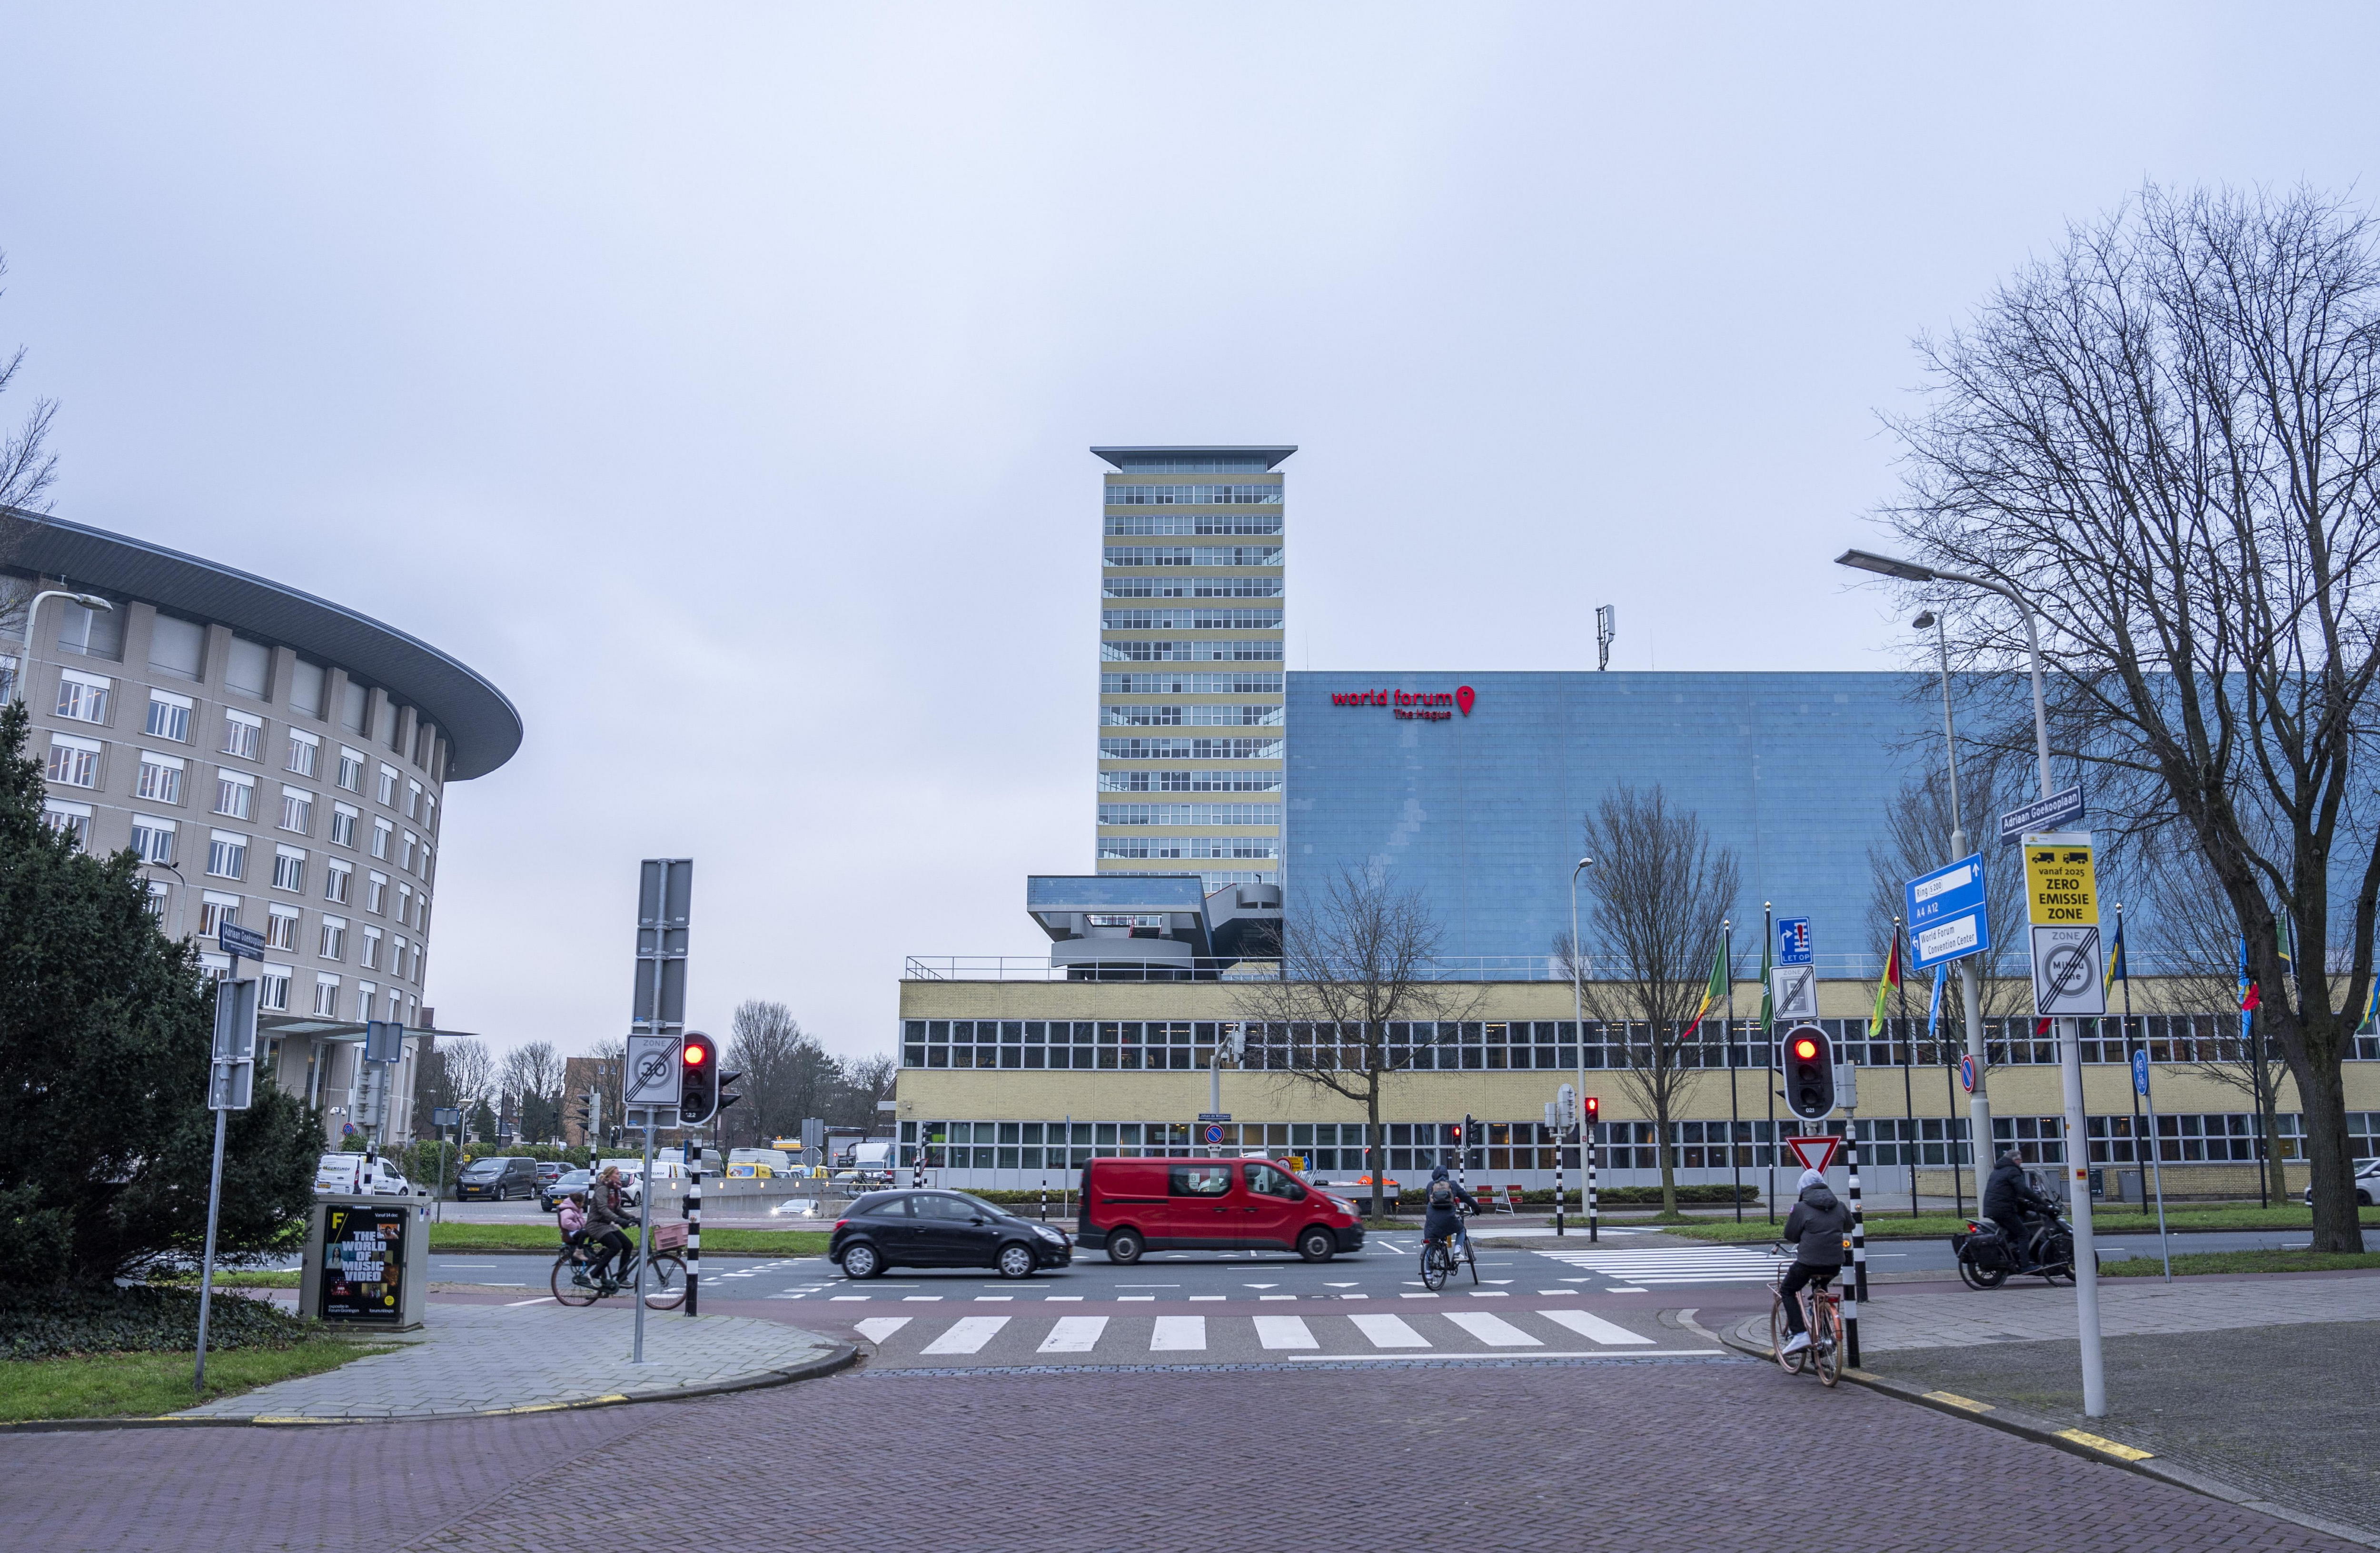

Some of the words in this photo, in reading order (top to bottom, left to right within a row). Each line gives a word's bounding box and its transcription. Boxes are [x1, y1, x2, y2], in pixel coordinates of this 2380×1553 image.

[1332, 689, 1387, 705] world
[1394, 689, 1452, 705] forum
[1394, 709, 1413, 719] The
[1417, 709, 1452, 721] Hague
[2004, 812, 2030, 829] Adriaan
[2031, 793, 2077, 818] Goekooplaan
[2046, 879, 2079, 889] ZERO
[1917, 887, 1928, 898] Ring
[2039, 894, 2089, 904] EMISSIE
[1917, 907, 1925, 918] A4
[1928, 902, 1938, 914] A12
[2048, 908, 2082, 919] ZONE
[225, 926, 240, 939] Adriaan
[241, 931, 264, 947] Goekooplaan
[1921, 931, 1936, 944] World
[1937, 926, 1954, 938] Forum
[2052, 932, 2081, 940] ZONE
[1928, 941, 1956, 955] Convention
[1957, 934, 1974, 946] Center
[2053, 961, 2084, 969] Milu
[641, 1062, 666, 1077] 30
[332, 1213, 344, 1229] F
[353, 1231, 376, 1241] THE
[342, 1241, 387, 1251] WORLD
[356, 1251, 371, 1261] OF
[342, 1261, 384, 1271] MUSIC
[345, 1271, 381, 1282] VIDEO
